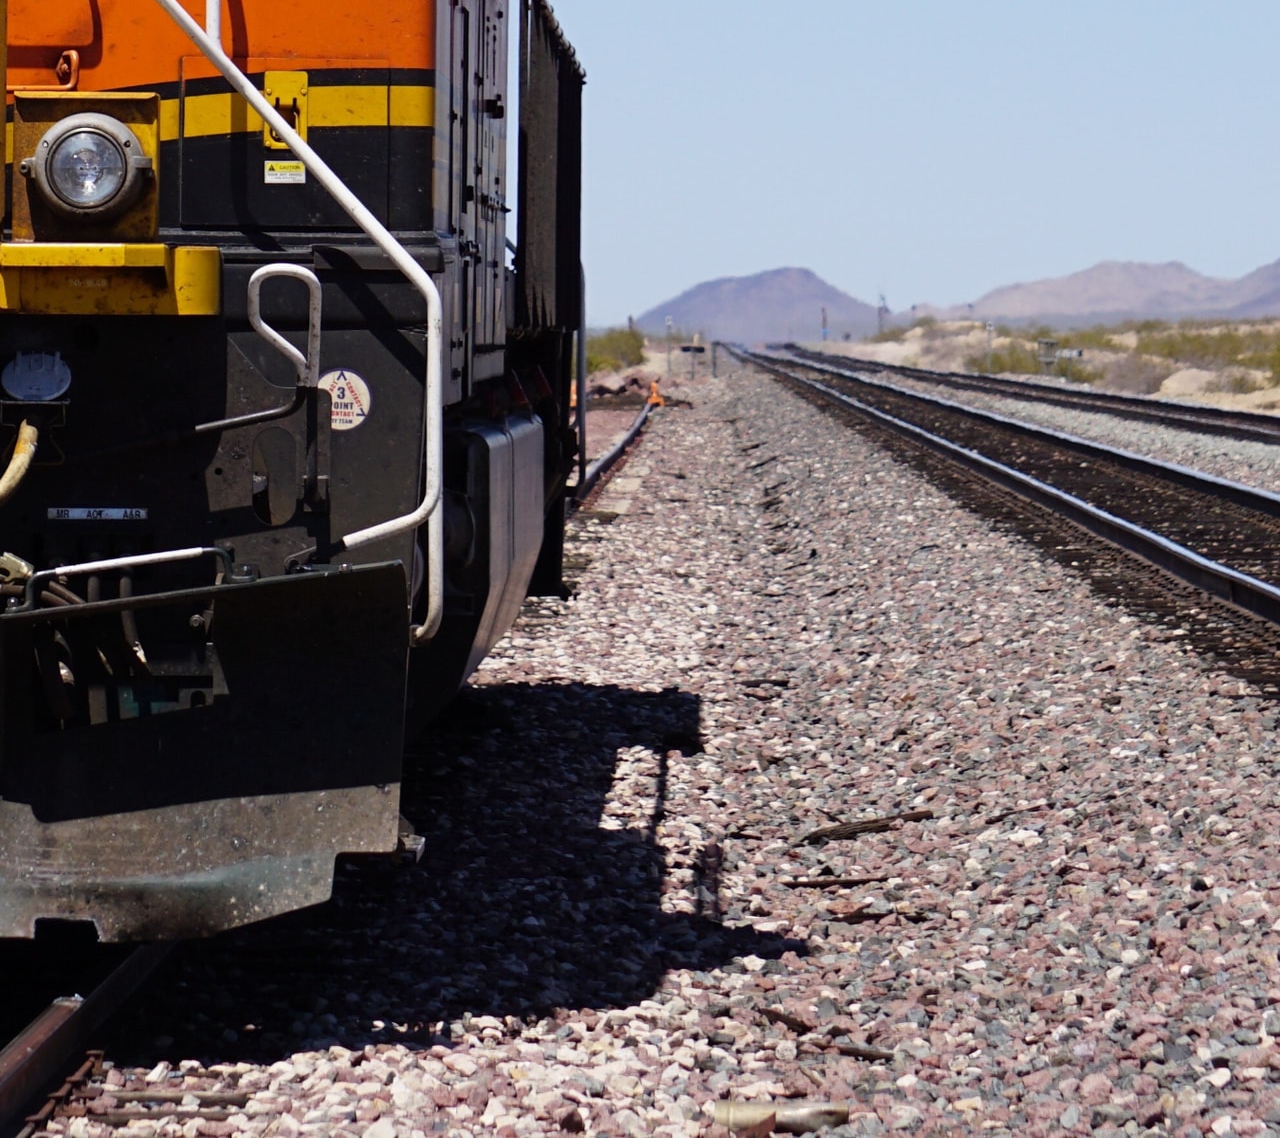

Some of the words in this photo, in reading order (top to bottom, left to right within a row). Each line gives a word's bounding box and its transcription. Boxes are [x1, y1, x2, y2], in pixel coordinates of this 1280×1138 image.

[337, 386, 346, 400] 3
[332, 402, 354, 410] OINT
[56, 509, 70, 519] MR
